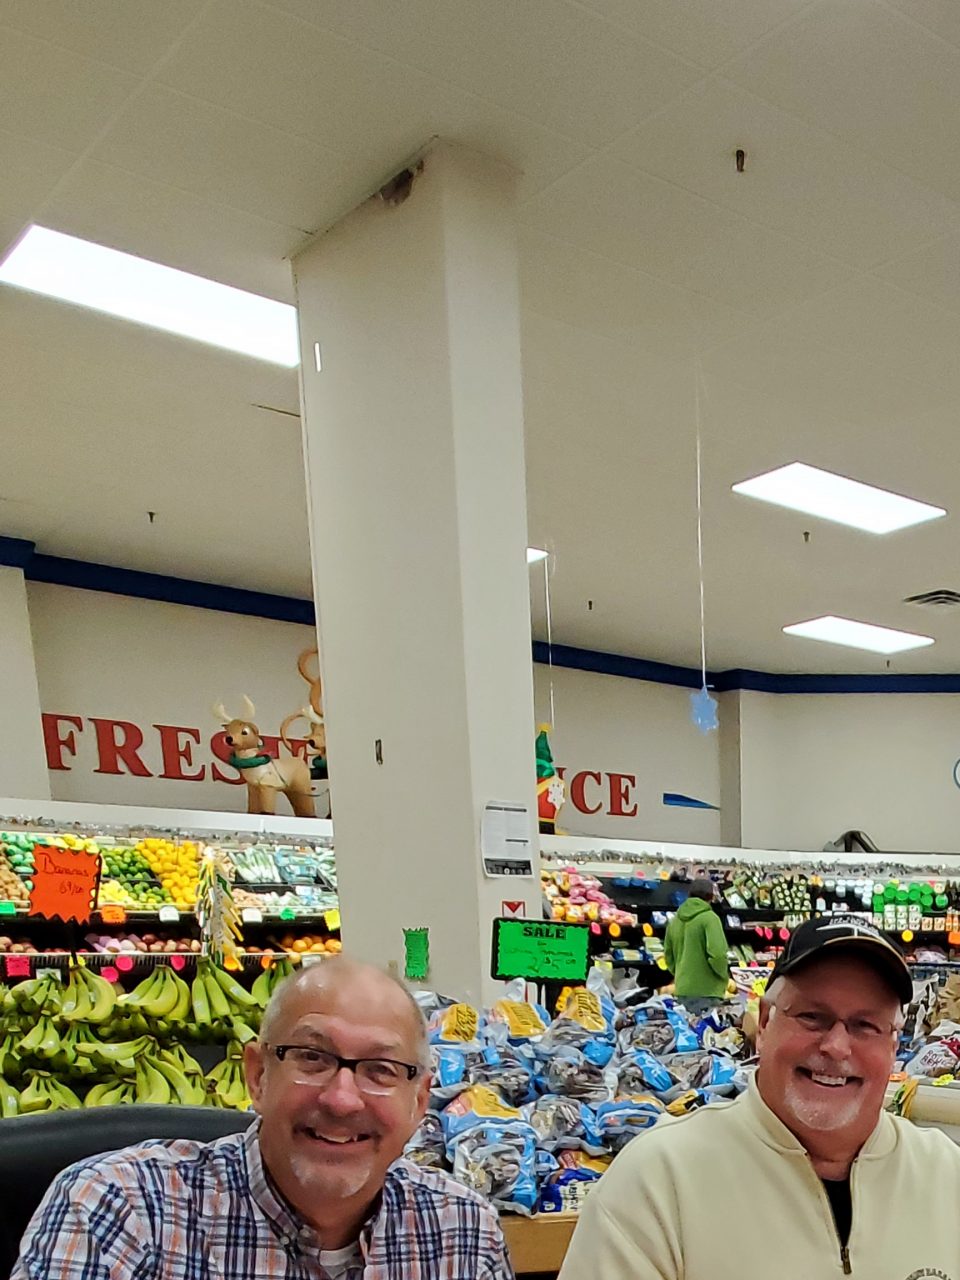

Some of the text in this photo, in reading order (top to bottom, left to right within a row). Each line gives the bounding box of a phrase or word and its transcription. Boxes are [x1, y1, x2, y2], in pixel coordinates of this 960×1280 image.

[41, 712, 638, 817] FRES CE
[522, 925, 566, 940] SALE
